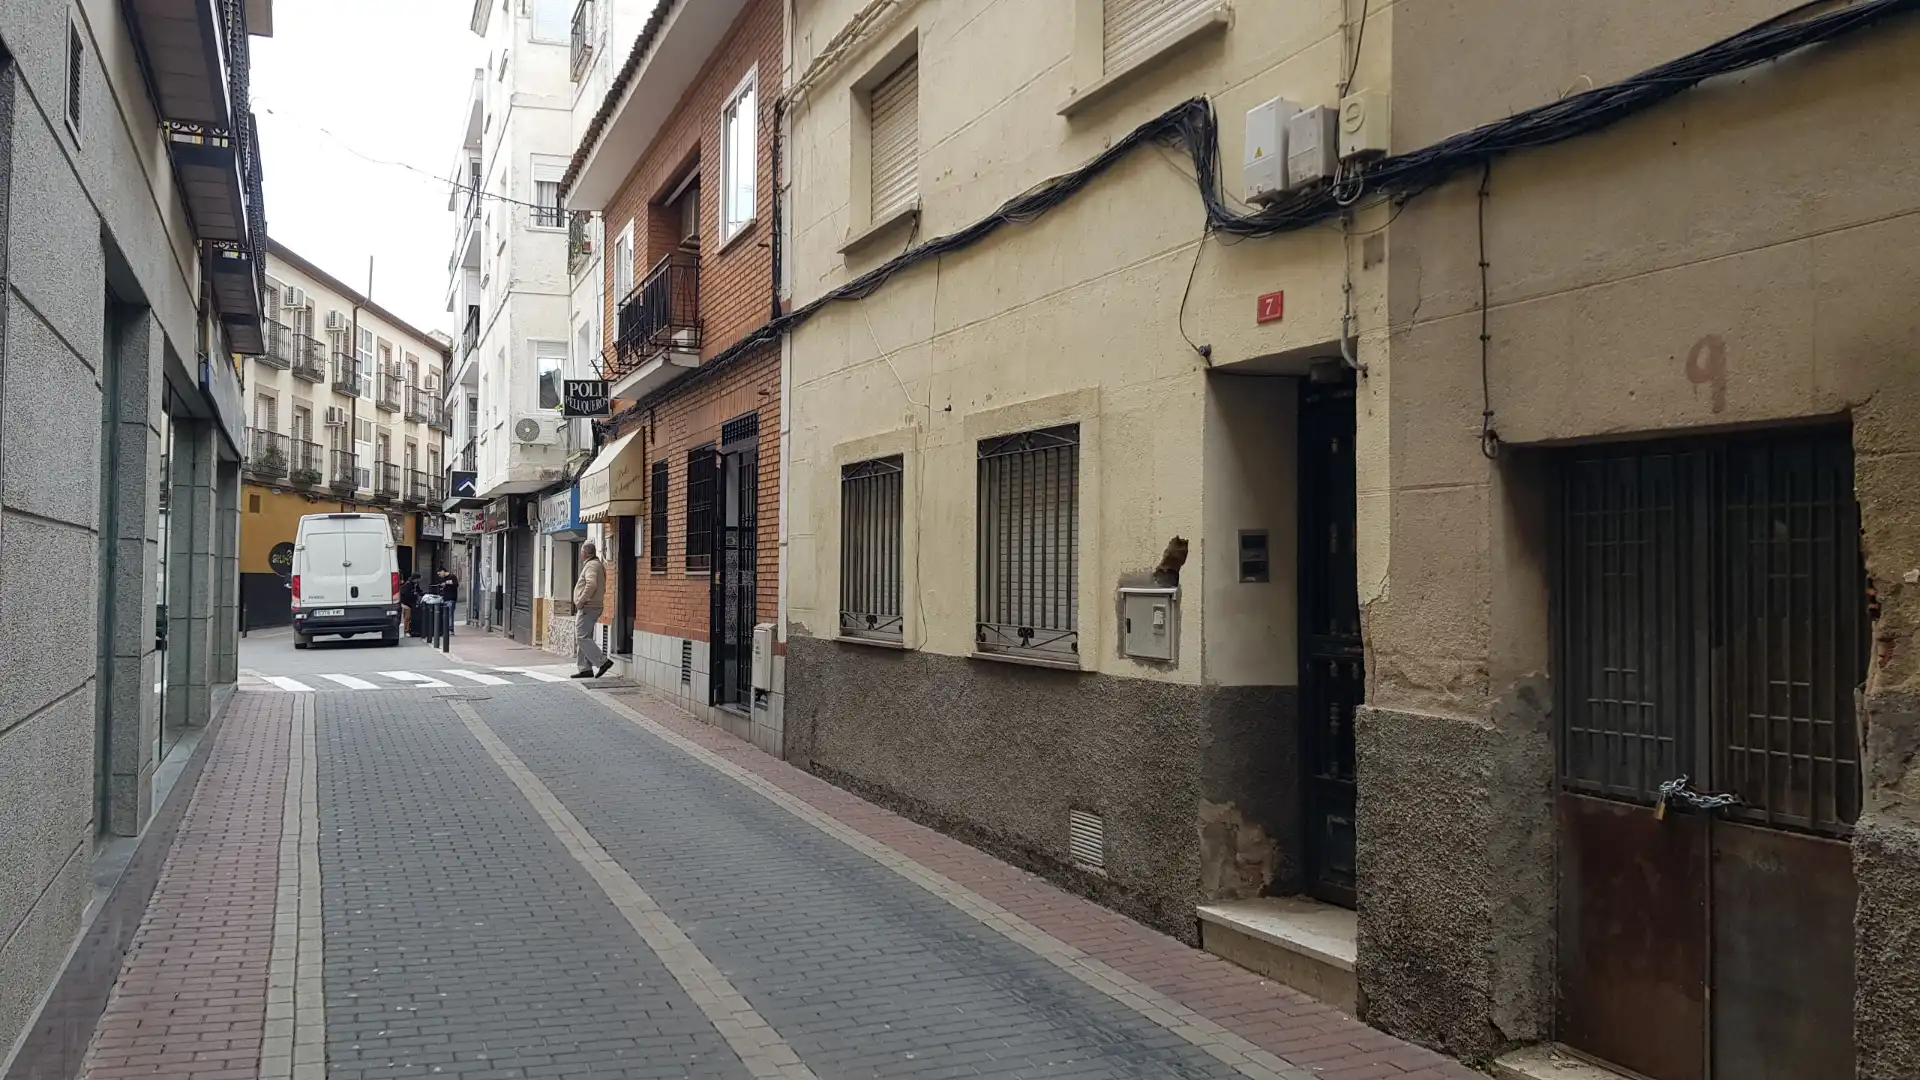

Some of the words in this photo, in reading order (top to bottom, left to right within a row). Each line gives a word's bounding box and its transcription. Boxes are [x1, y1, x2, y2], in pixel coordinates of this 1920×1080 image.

[1264, 297, 1273, 316] 7
[1686, 333, 1727, 414] 9
[569, 382, 603, 397] POLI
[565, 394, 609, 415] PELUQUEROS
